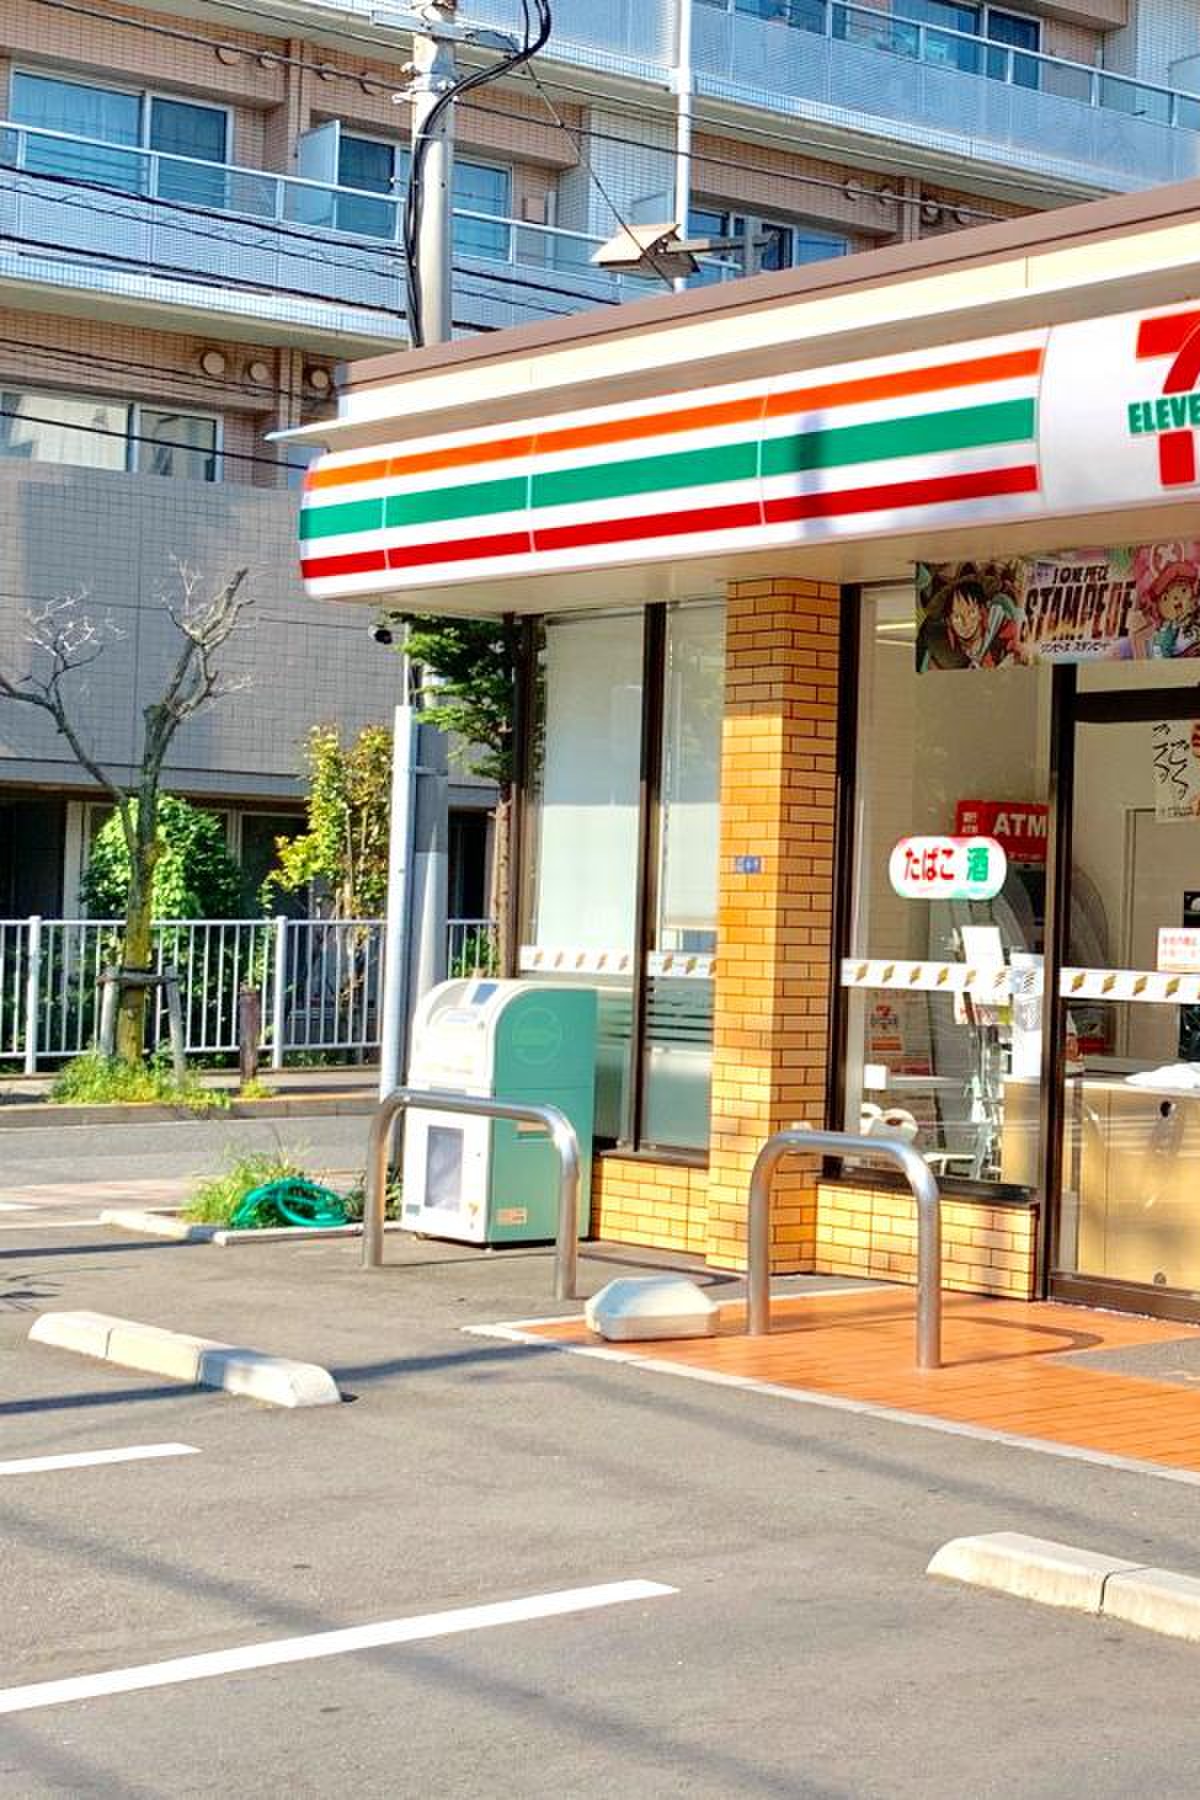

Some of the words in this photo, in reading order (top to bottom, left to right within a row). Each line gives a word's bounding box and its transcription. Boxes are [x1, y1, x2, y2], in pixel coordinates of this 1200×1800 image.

[992, 812, 1047, 838] ATM
[904, 846, 955, 882] たばこ
[966, 847, 990, 882] 酒
